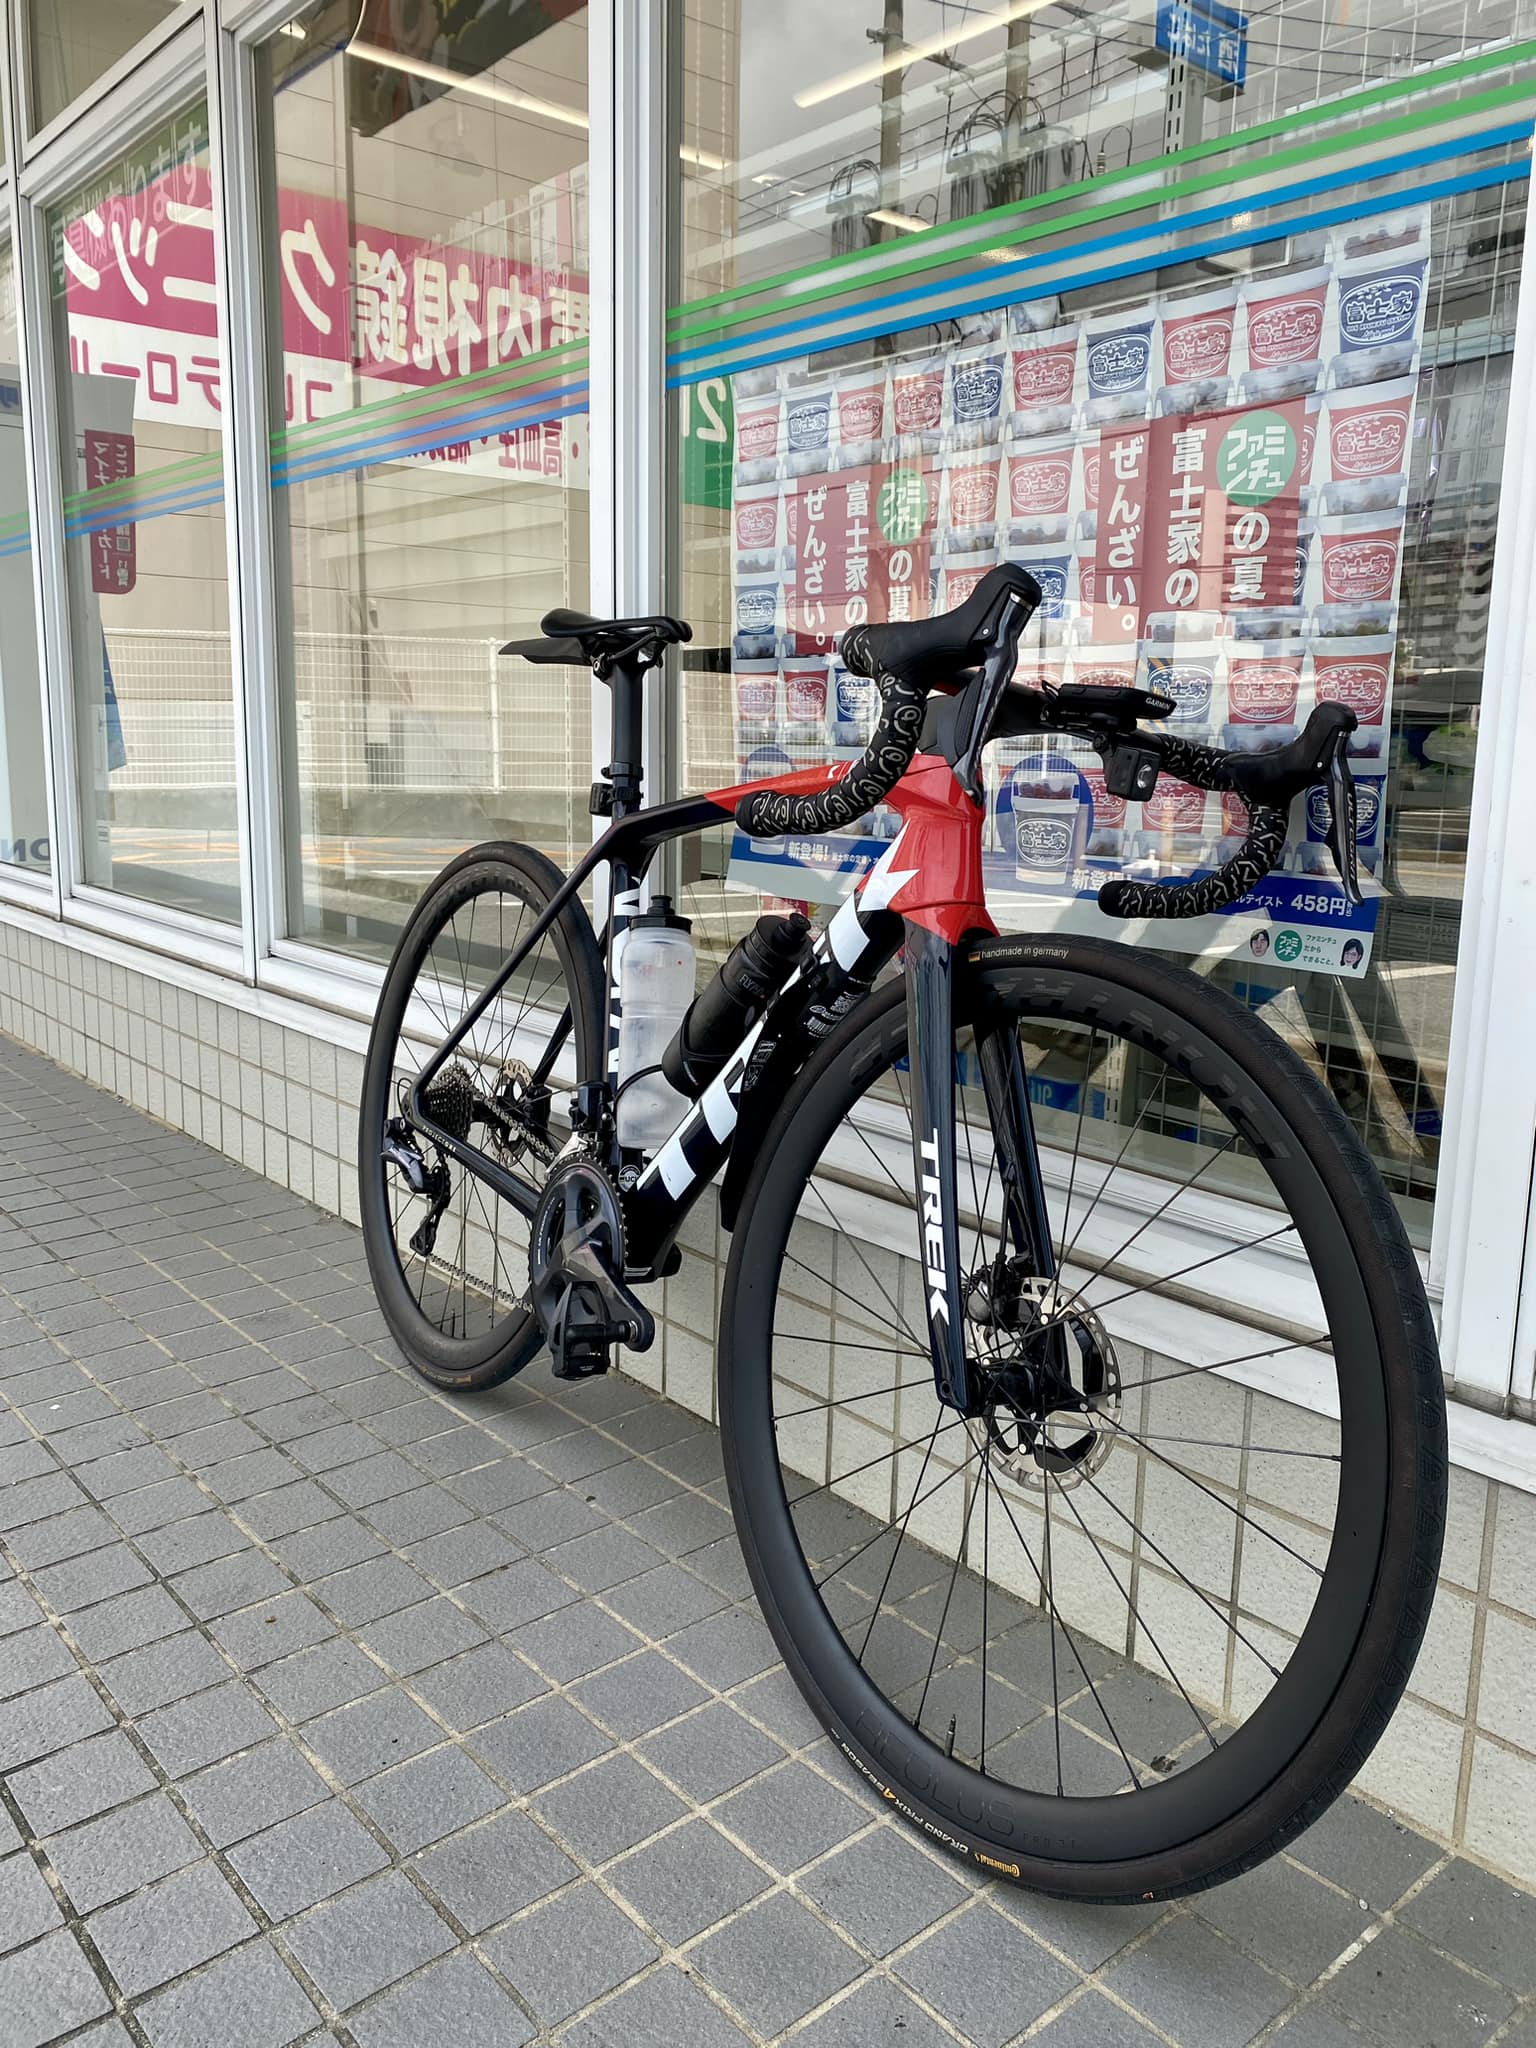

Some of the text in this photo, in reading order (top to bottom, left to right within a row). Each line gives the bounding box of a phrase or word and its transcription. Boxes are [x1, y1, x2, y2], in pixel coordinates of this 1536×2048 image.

[1346, 290, 1413, 325] 富士家
[1254, 313, 1317, 347] 富士家
[1093, 346, 1144, 375] 富士家
[1169, 332, 1226, 362] 富士家
[1337, 424, 1401, 455] 富士家
[1015, 472, 1066, 496] 富士家
[1106, 435, 1145, 630] ぜんざい。
[1165, 427, 1207, 607] 富士家の
[803, 485, 828, 647] ぜんざい。
[845, 480, 869, 625] 富士家の
[1229, 512, 1270, 601] の夏
[1329, 554, 1390, 580] 富士家
[1235, 677, 1294, 701] 富士家
[1320, 678, 1381, 701] 富士家
[1020, 829, 1068, 850] 富士家
[981, 945, 1022, 959] handmade
[1033, 947, 1069, 960] germany
[920, 1127, 950, 1326] TREK
[841, 1742, 886, 1791] SEASON
[894, 1798, 924, 1825] PRIX
[924, 1822, 969, 1853] GRAND
